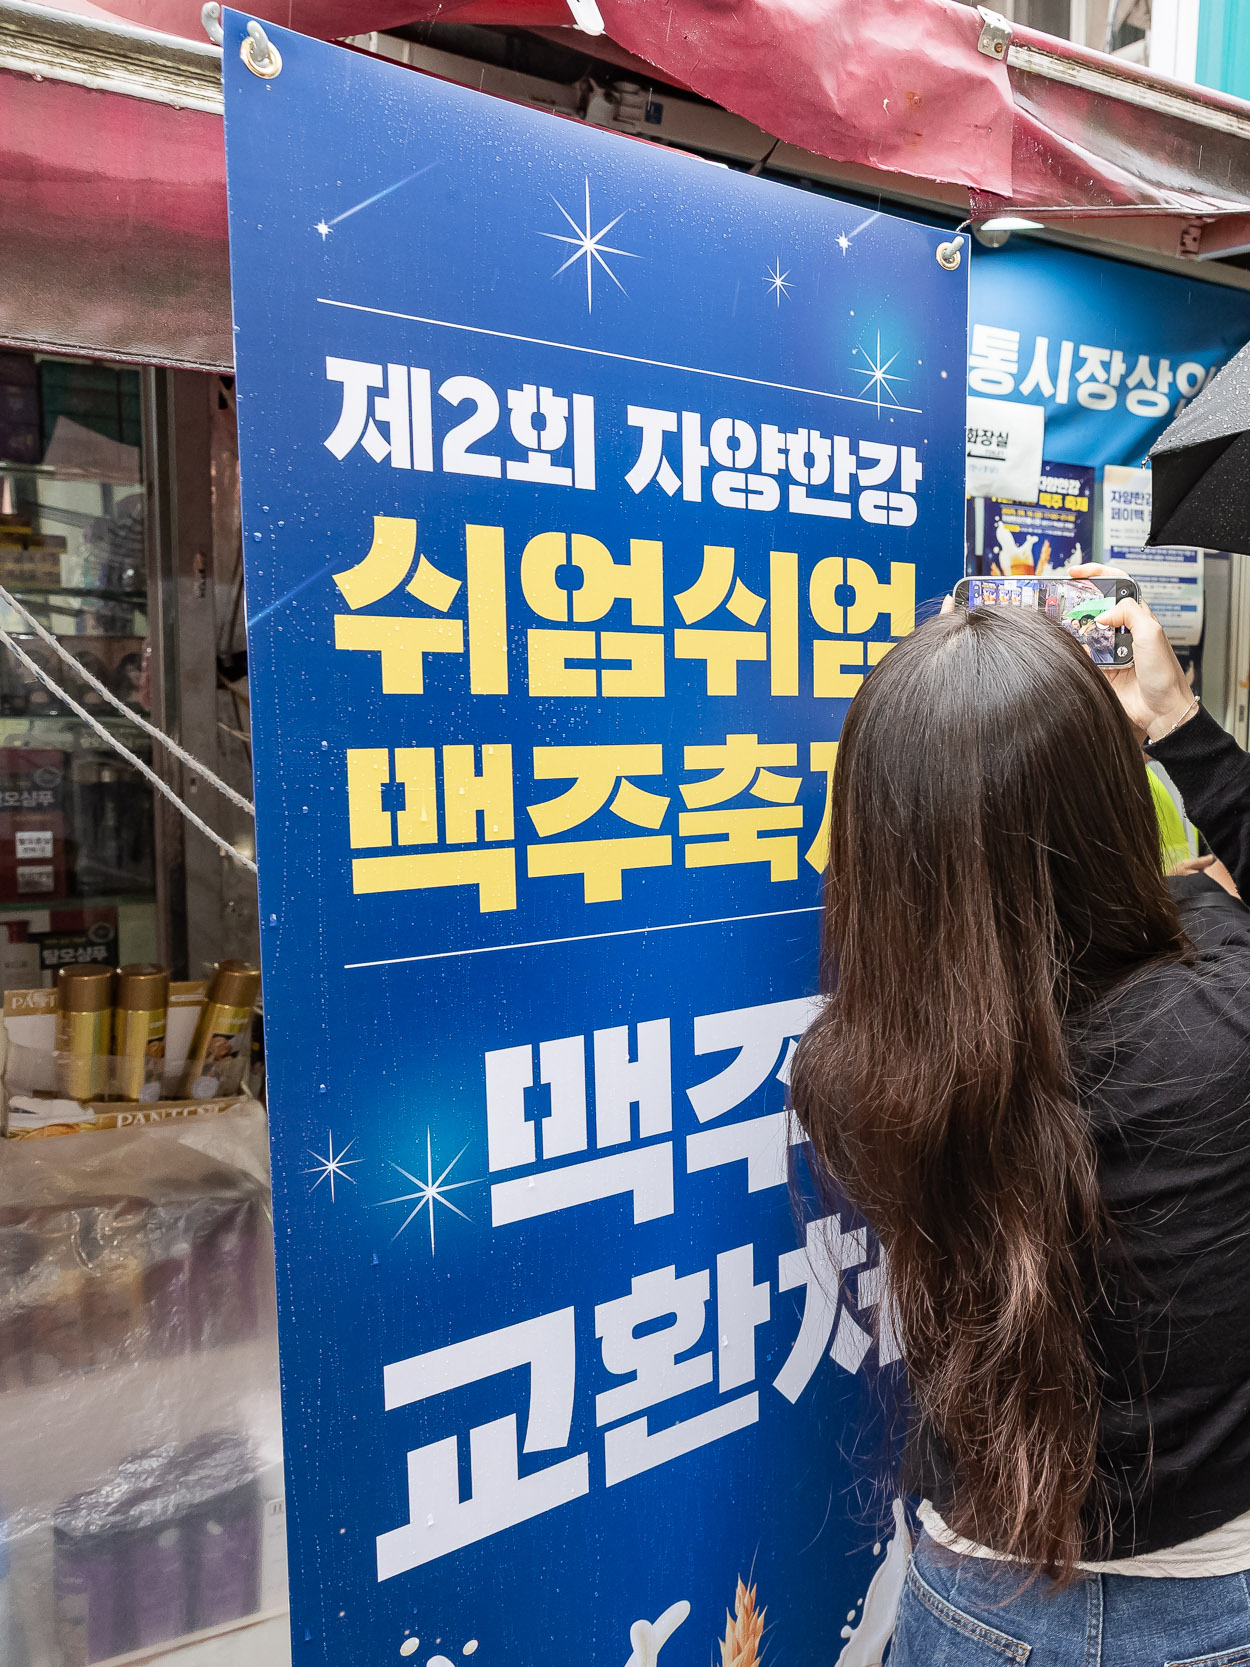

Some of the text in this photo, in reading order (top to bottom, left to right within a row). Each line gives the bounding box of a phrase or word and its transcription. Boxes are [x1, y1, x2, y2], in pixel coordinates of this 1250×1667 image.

[323, 356, 923, 527] 제2회 자양한강
[967, 428, 1009, 449] 화장실
[332, 515, 917, 699] 쉬엄쉬엄
